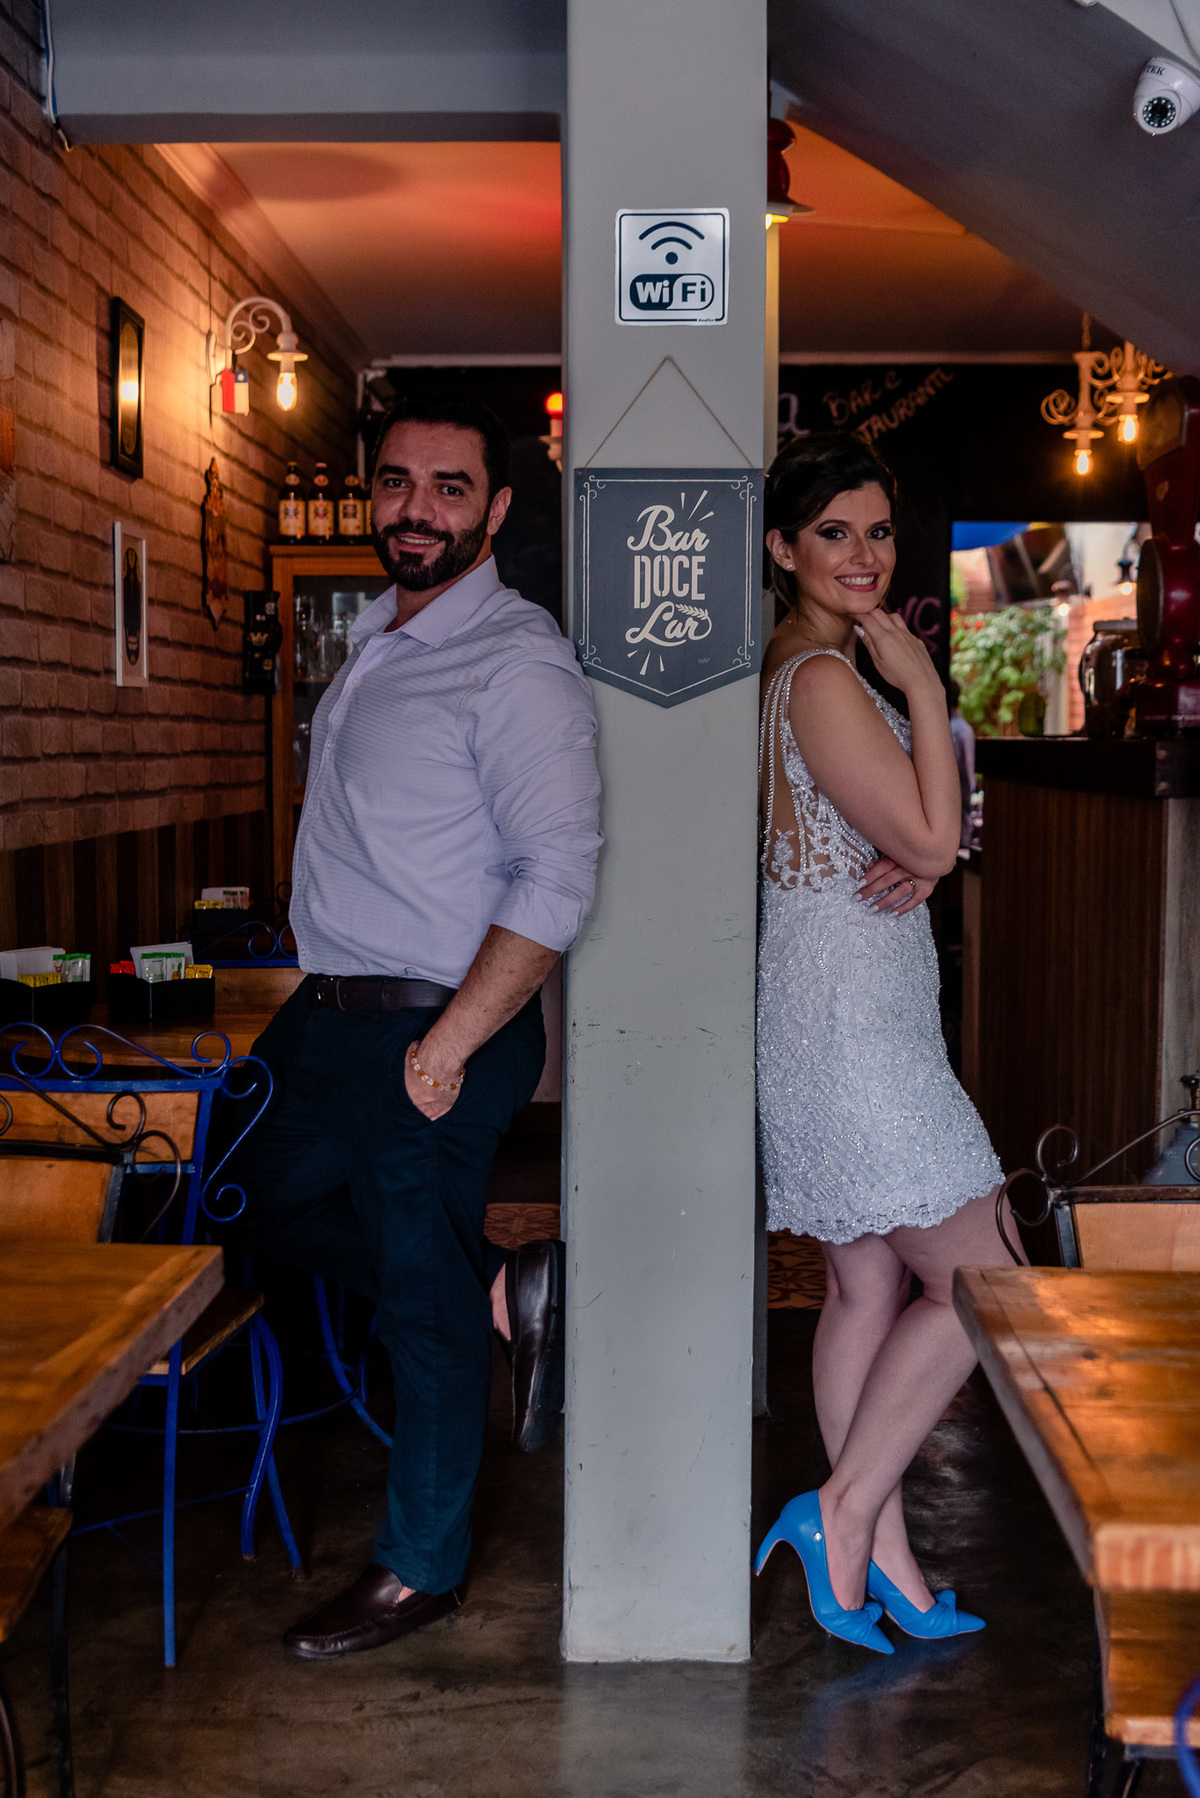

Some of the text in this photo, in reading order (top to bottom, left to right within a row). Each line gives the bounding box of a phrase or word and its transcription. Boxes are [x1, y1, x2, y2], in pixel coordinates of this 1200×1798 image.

[1144, 64, 1166, 76] TEK
[856, 366, 955, 441] TAURANTE
[626, 504, 710, 552] Bar
[633, 554, 706, 609] DOCE
[625, 600, 713, 647] Lar
